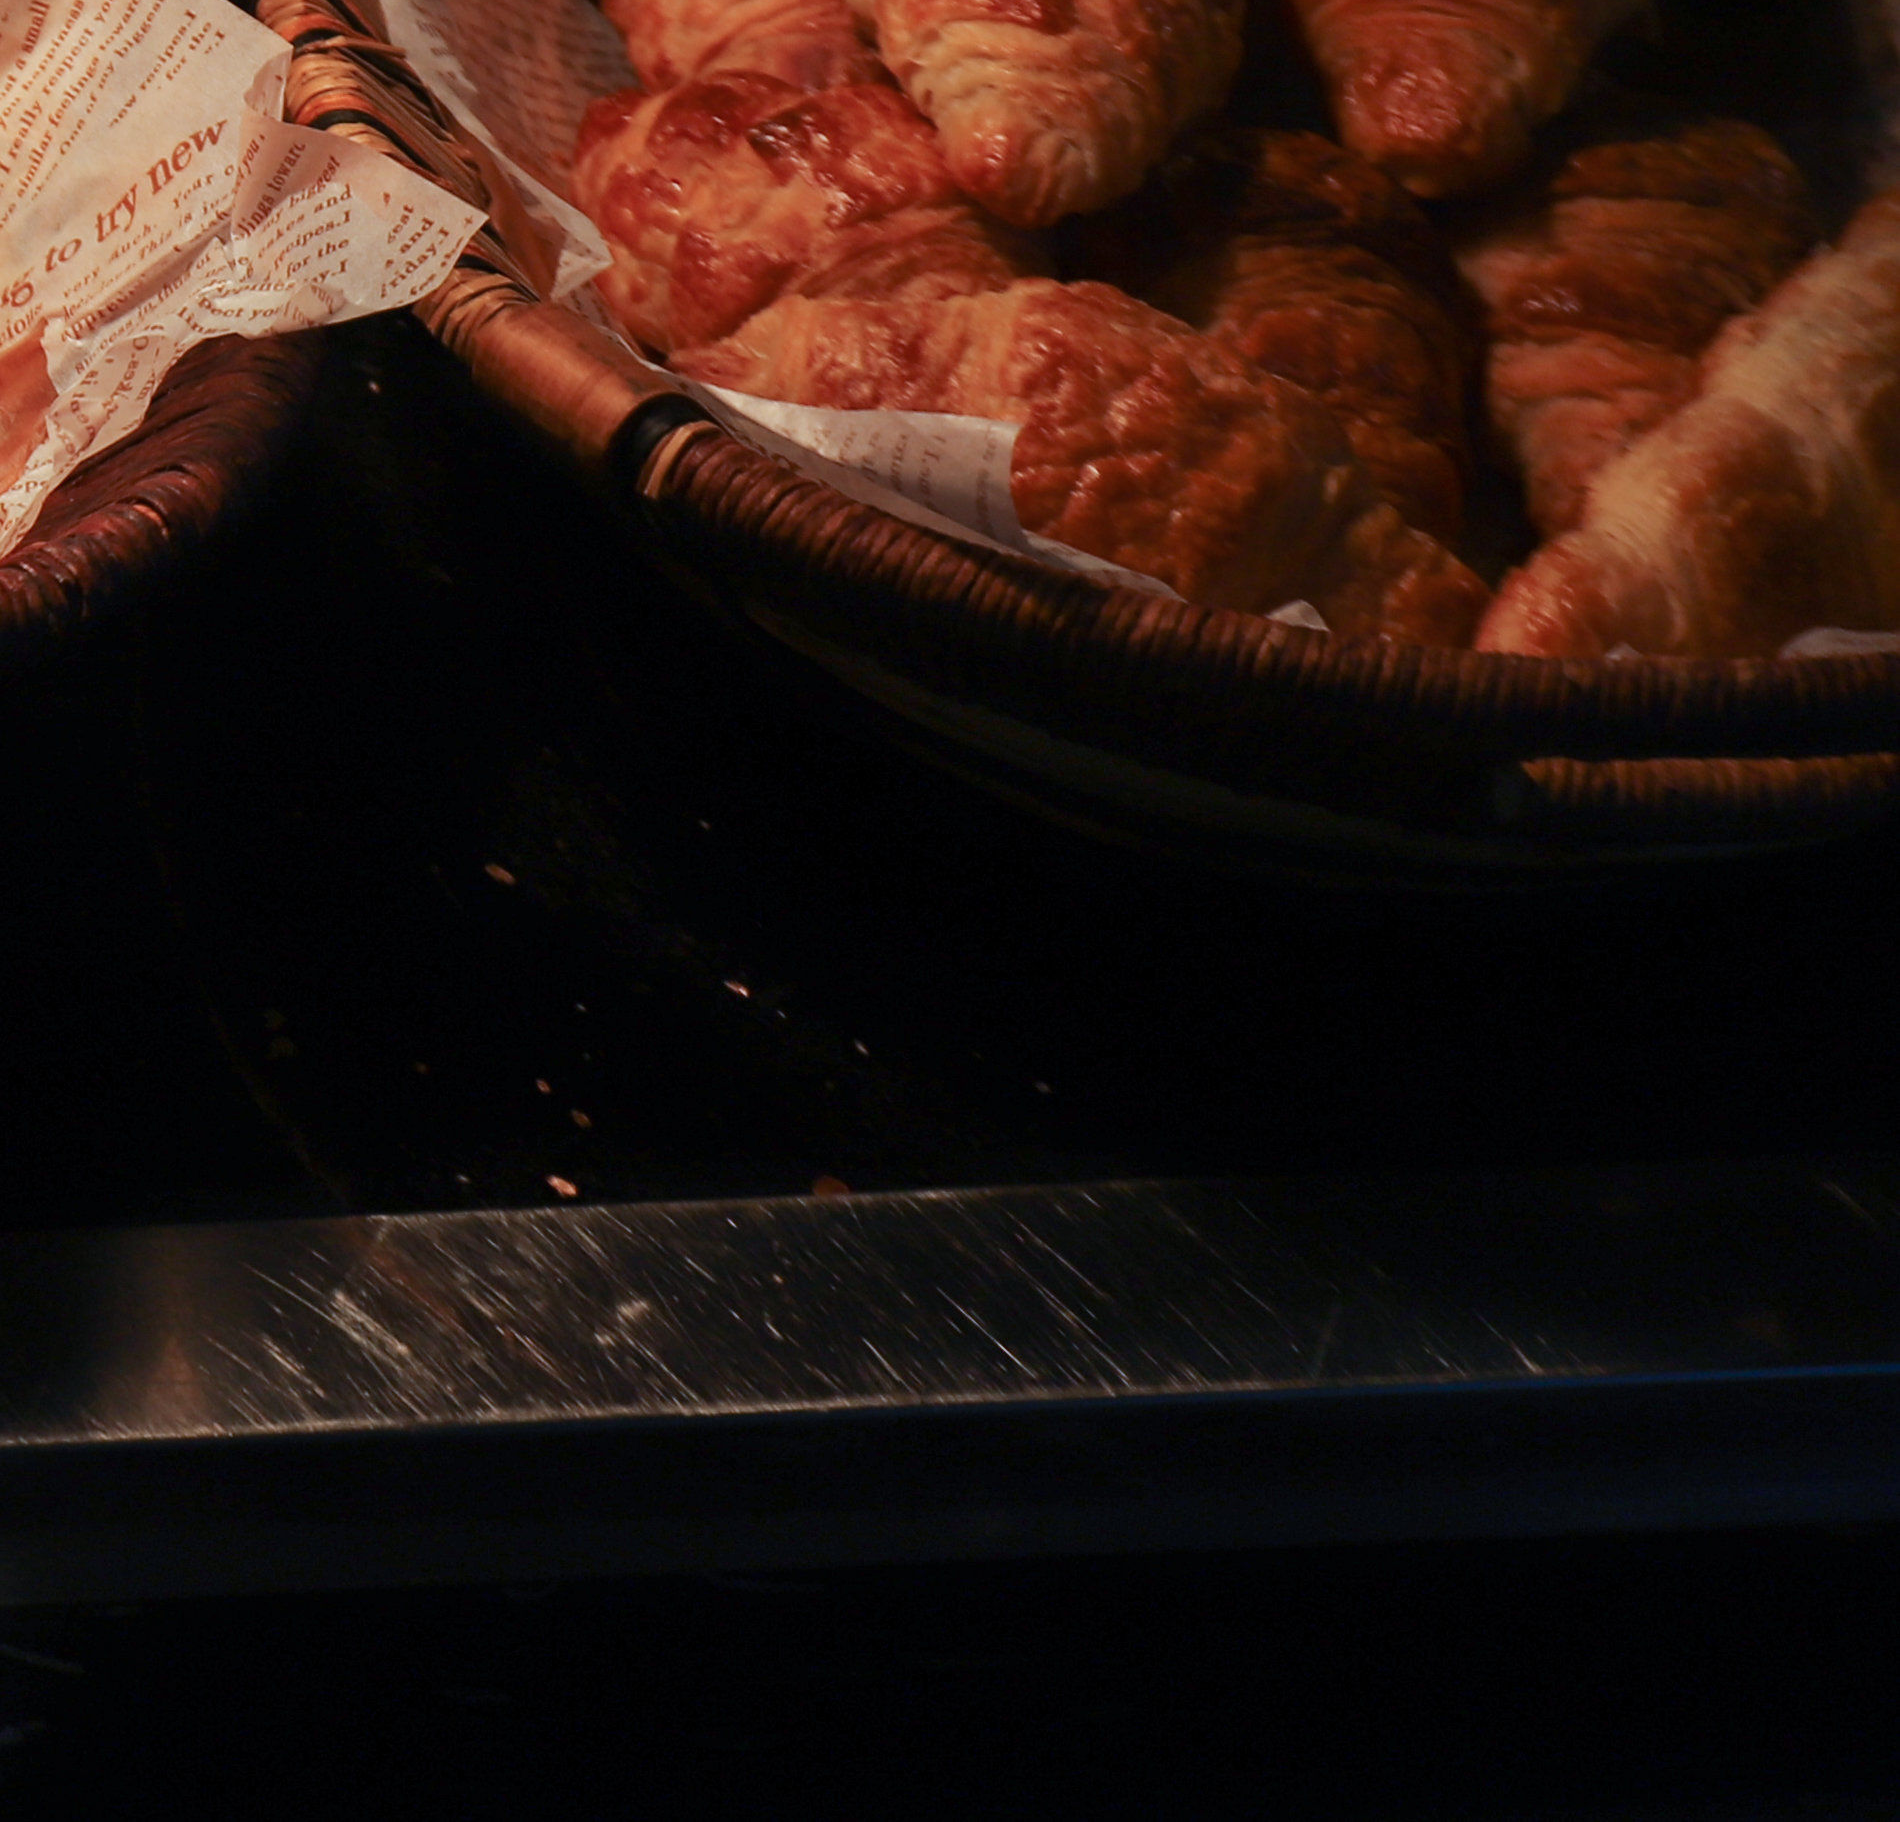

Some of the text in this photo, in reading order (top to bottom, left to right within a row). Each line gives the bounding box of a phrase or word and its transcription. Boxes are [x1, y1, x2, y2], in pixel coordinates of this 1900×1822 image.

[20, 0, 51, 55] small
[188, 22, 212, 51] the
[8, 100, 43, 160] really
[41, 28, 95, 96] respect
[17, 131, 53, 198] similar
[48, 56, 100, 128] feelings
[44, 117, 230, 274] to try new
[313, 182, 352, 214] and
[286, 239, 350, 279] for the
[390, 217, 435, 254] and
